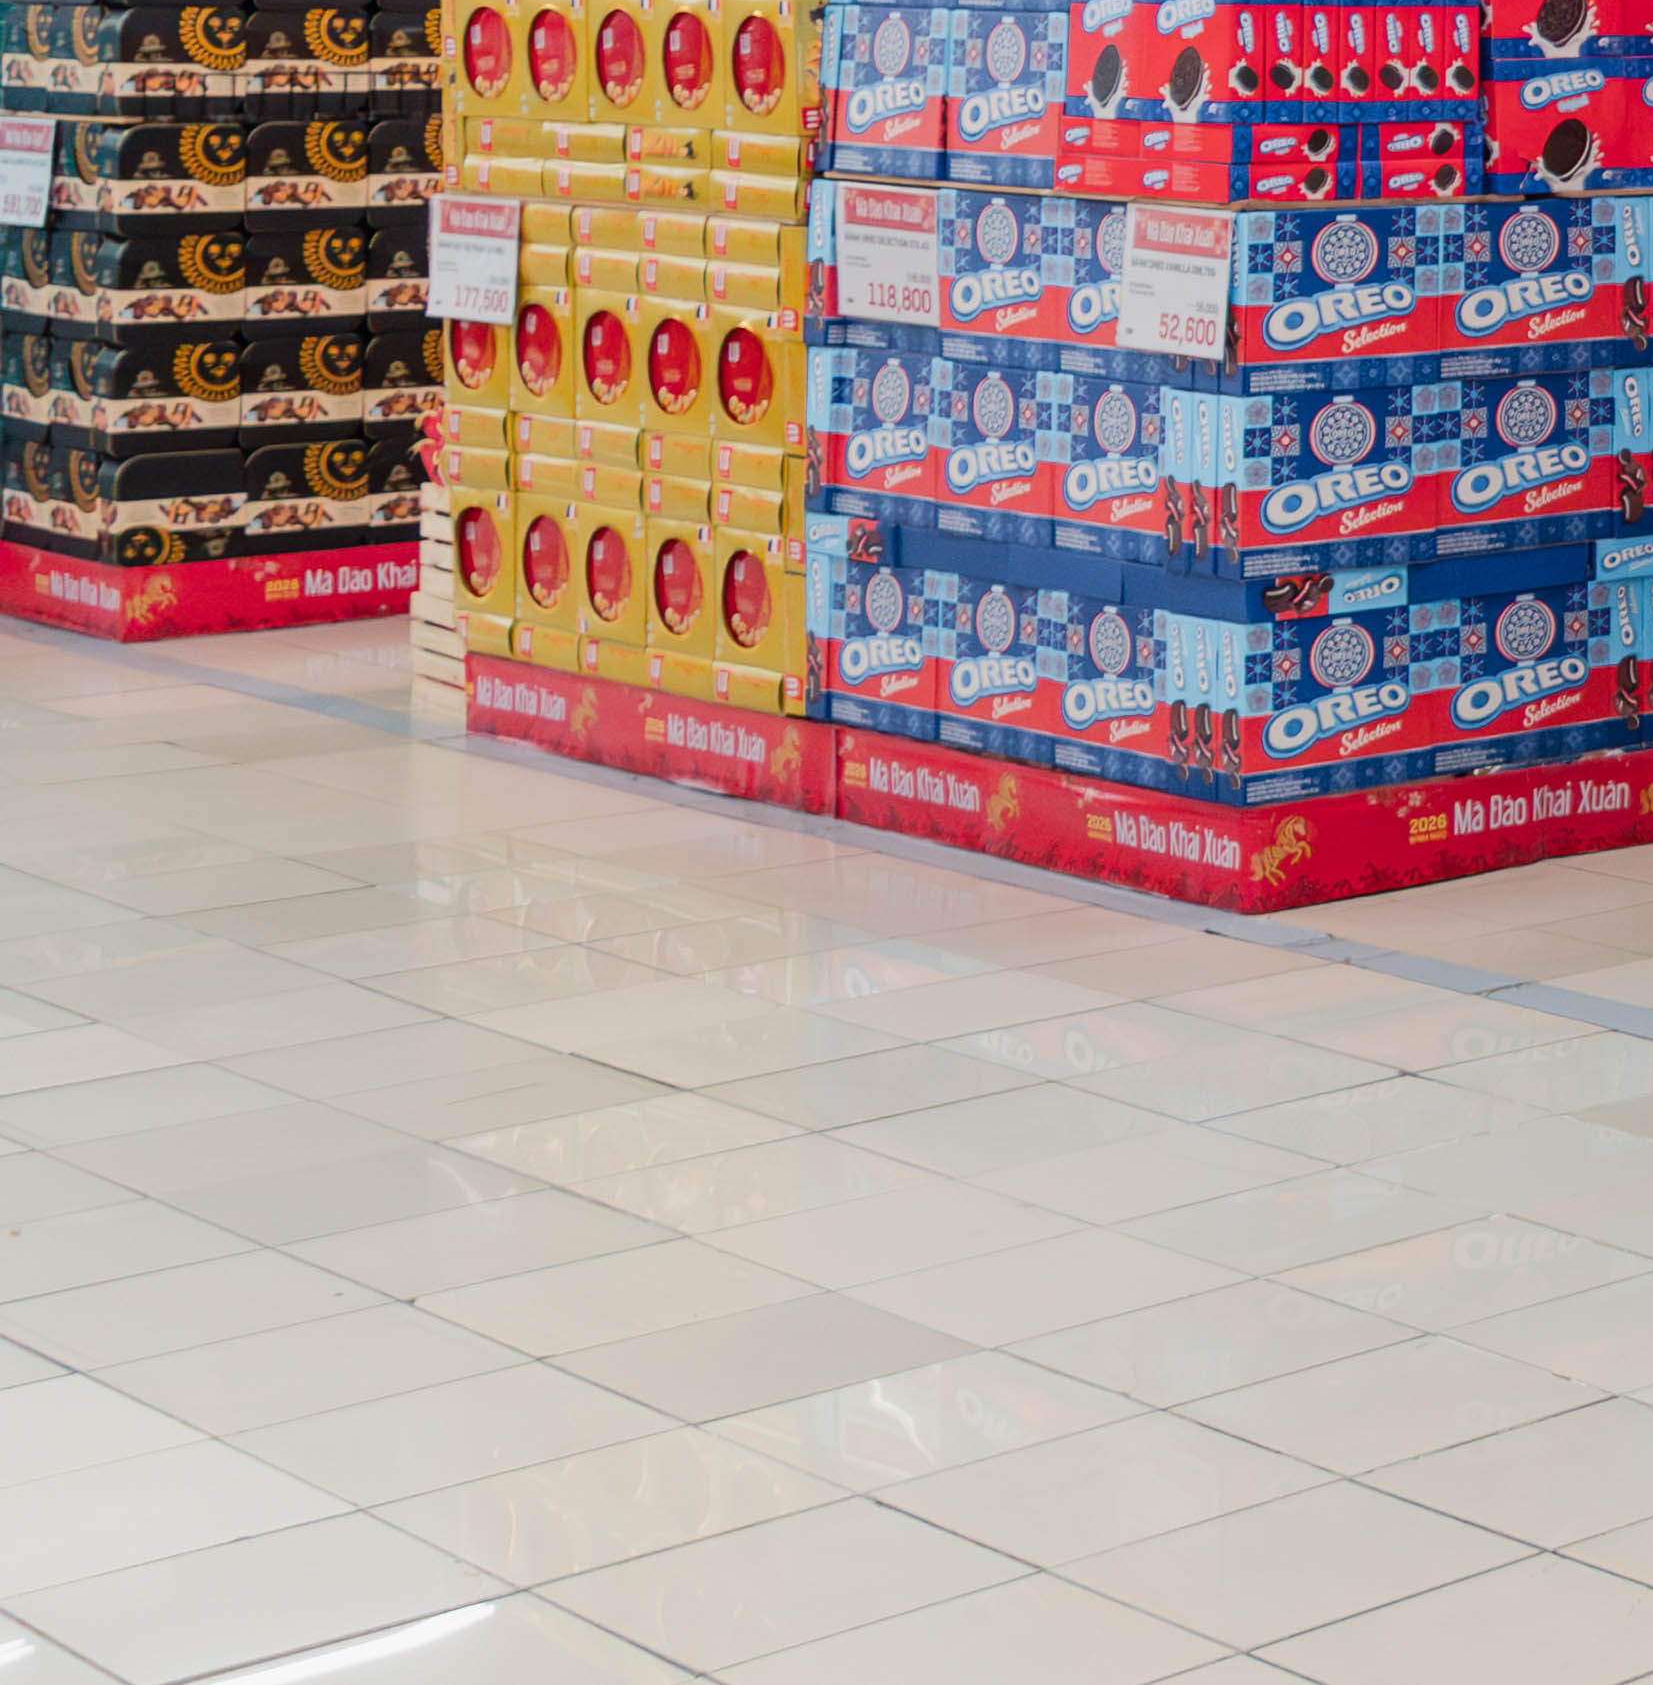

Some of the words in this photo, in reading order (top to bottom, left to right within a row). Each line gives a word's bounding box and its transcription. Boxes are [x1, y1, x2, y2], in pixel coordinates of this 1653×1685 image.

[868, 282, 931, 314] 118,800
[1263, 281, 1416, 350] OREO
[1455, 269, 1594, 336] OREO
[1159, 313, 1216, 347] 52,600
[1342, 321, 1407, 354] Selection
[1528, 307, 1587, 340] Selection
[1451, 654, 1590, 729] OREO
[1522, 691, 1582, 728] Selection
[1409, 816, 1446, 835] 2026
[1453, 800, 1486, 835] Mã
[1491, 792, 1527, 827] Đáo
[1533, 787, 1571, 820] Khai
[1577, 779, 1630, 816] Xuân
